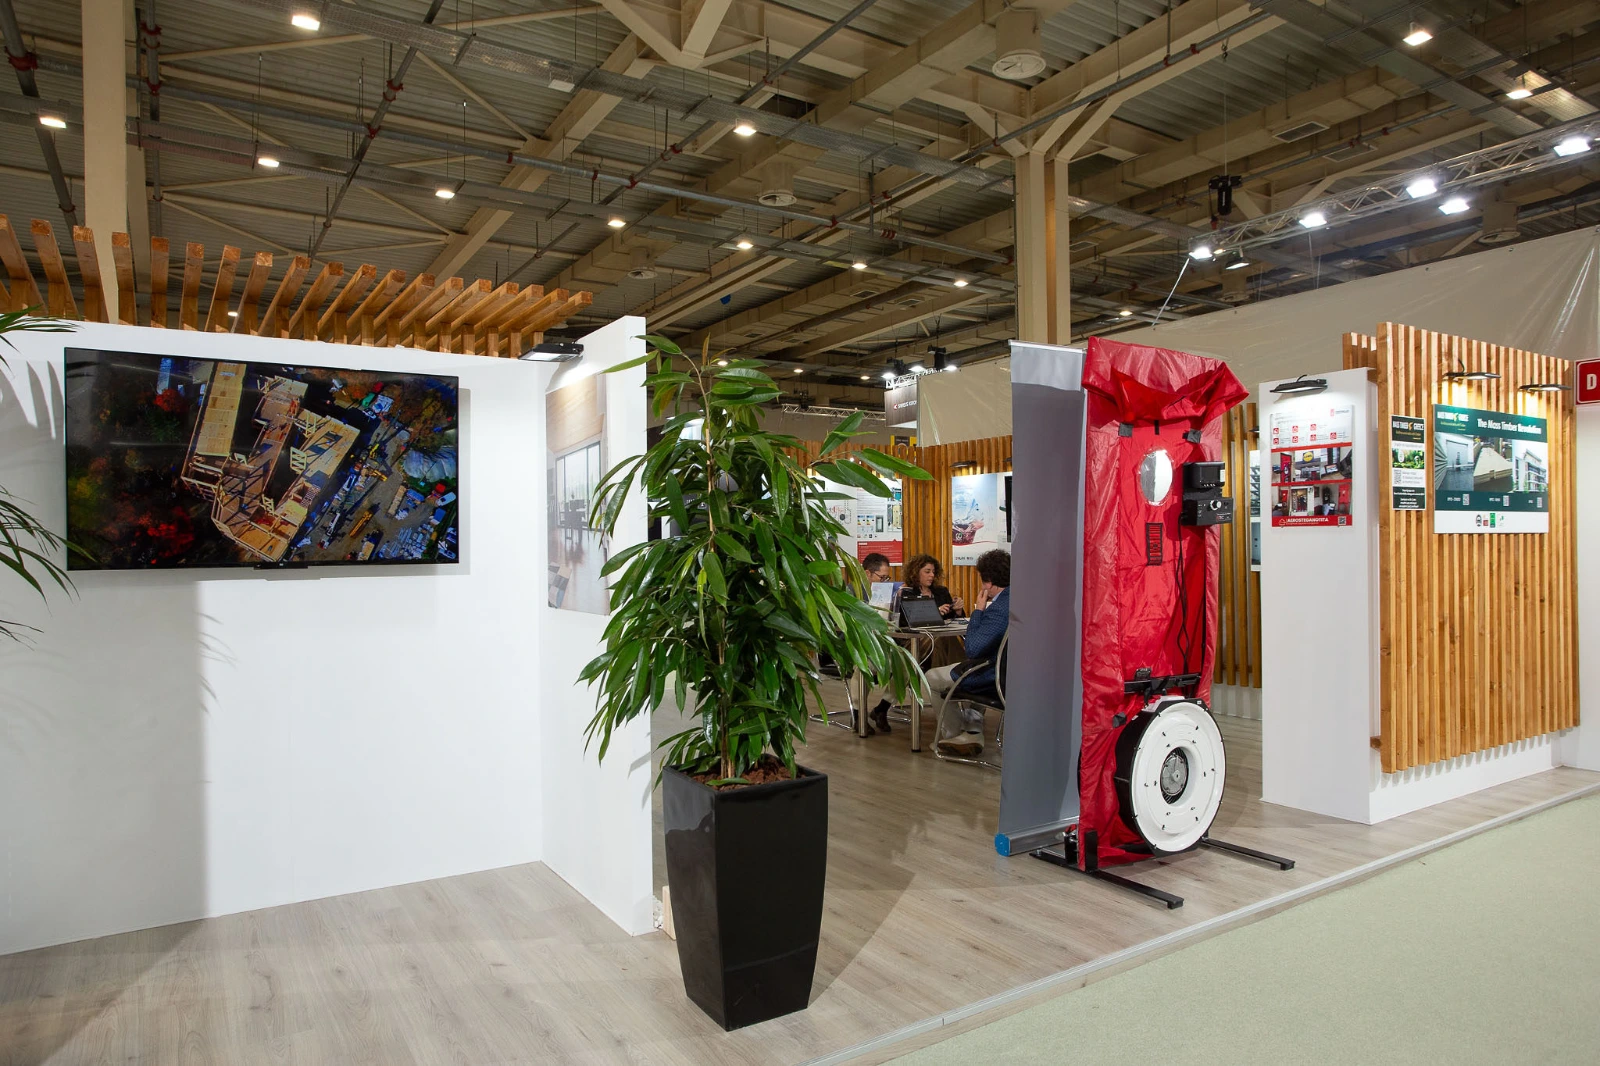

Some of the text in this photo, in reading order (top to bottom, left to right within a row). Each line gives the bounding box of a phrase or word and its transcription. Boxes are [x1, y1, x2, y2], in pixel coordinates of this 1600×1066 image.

[1586, 373, 1597, 390] D
[1477, 418, 1488, 428] The
[1487, 420, 1501, 430] Mass
[1501, 421, 1518, 432] Timber
[1517, 423, 1542, 435] Revolution
